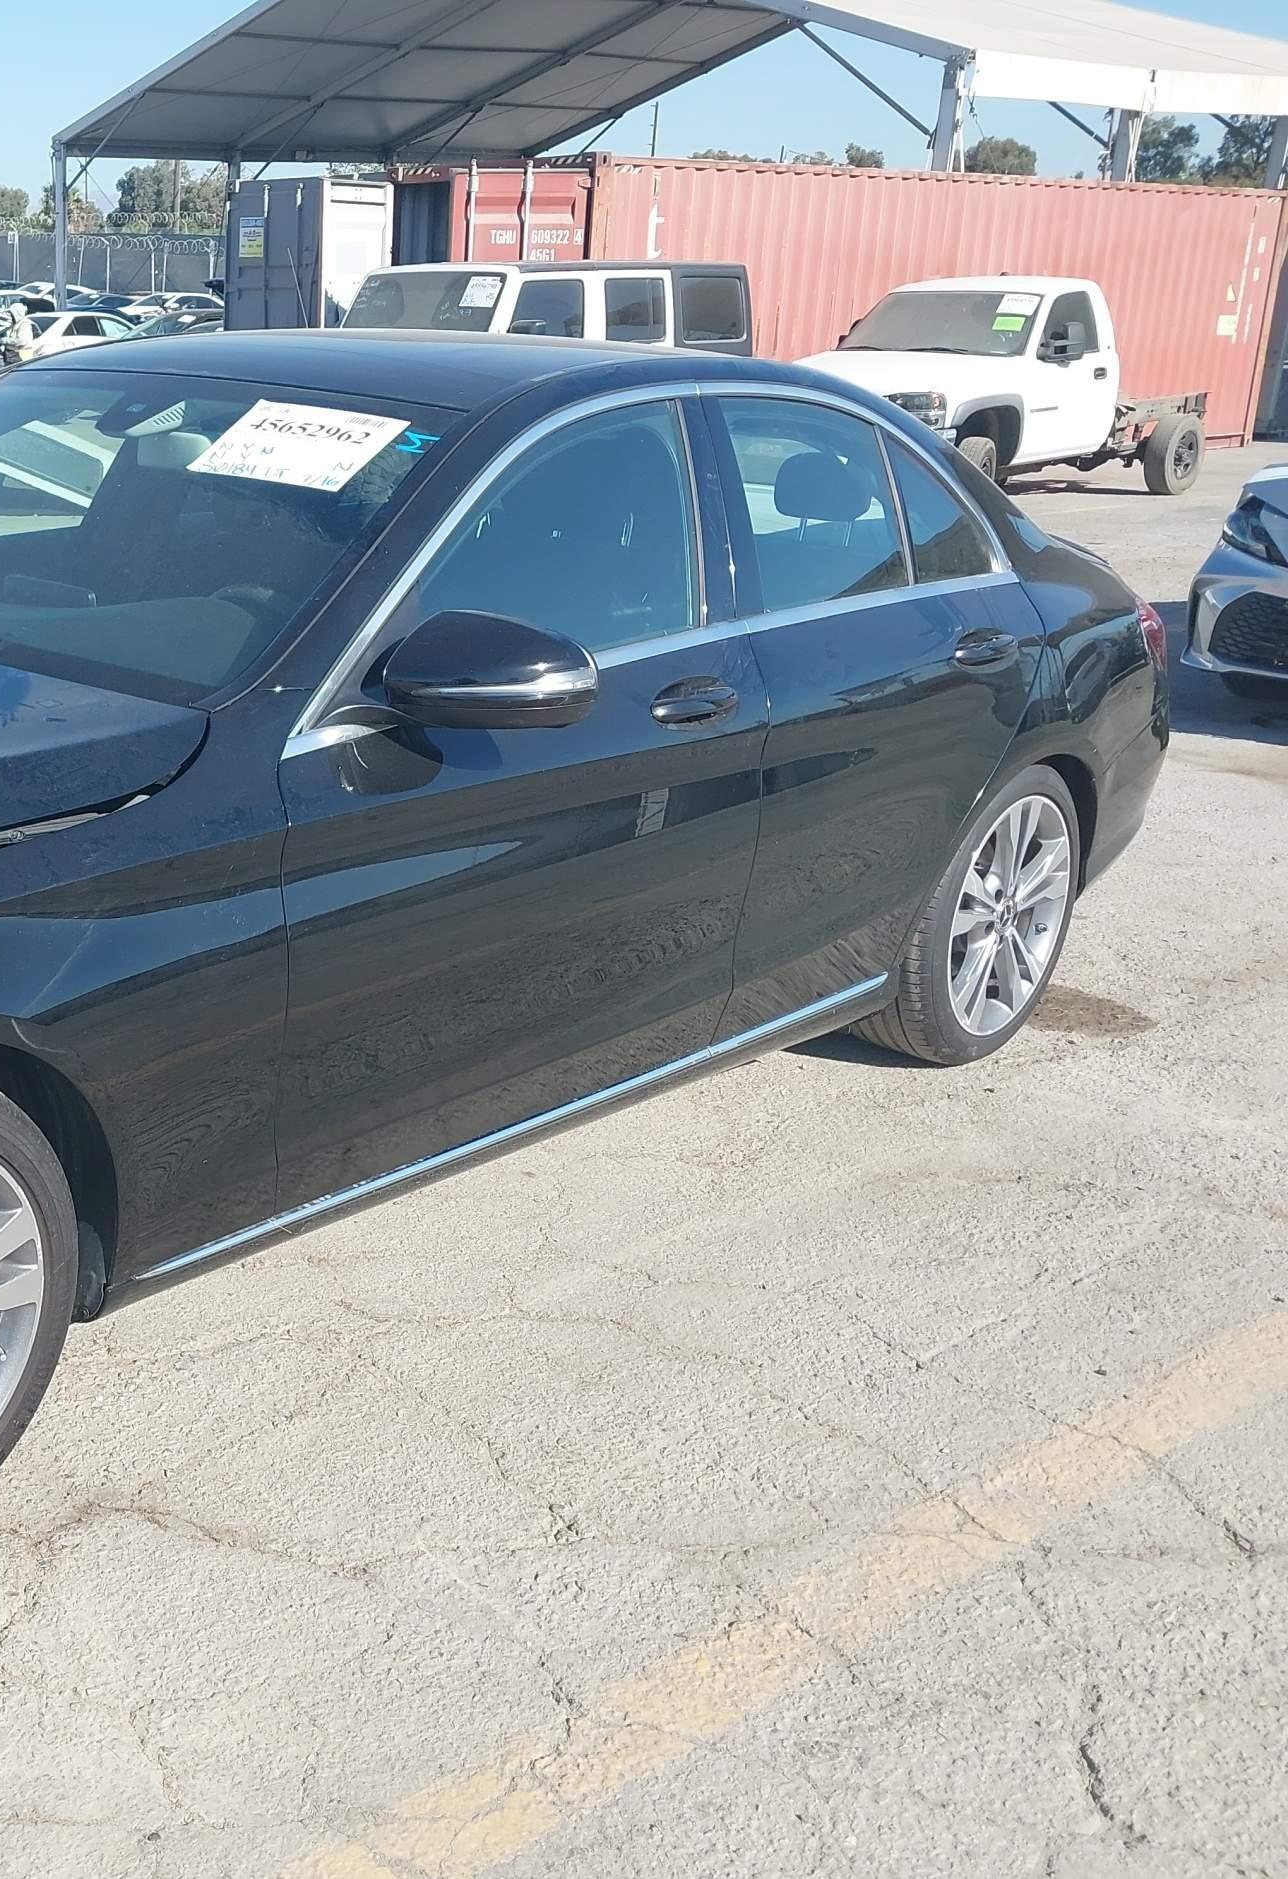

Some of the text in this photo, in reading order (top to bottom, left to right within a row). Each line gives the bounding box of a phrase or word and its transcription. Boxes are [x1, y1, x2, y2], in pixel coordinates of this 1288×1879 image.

[490, 229, 517, 244] TGHU
[532, 229, 570, 244] 609322
[250, 417, 371, 445] 45652962
